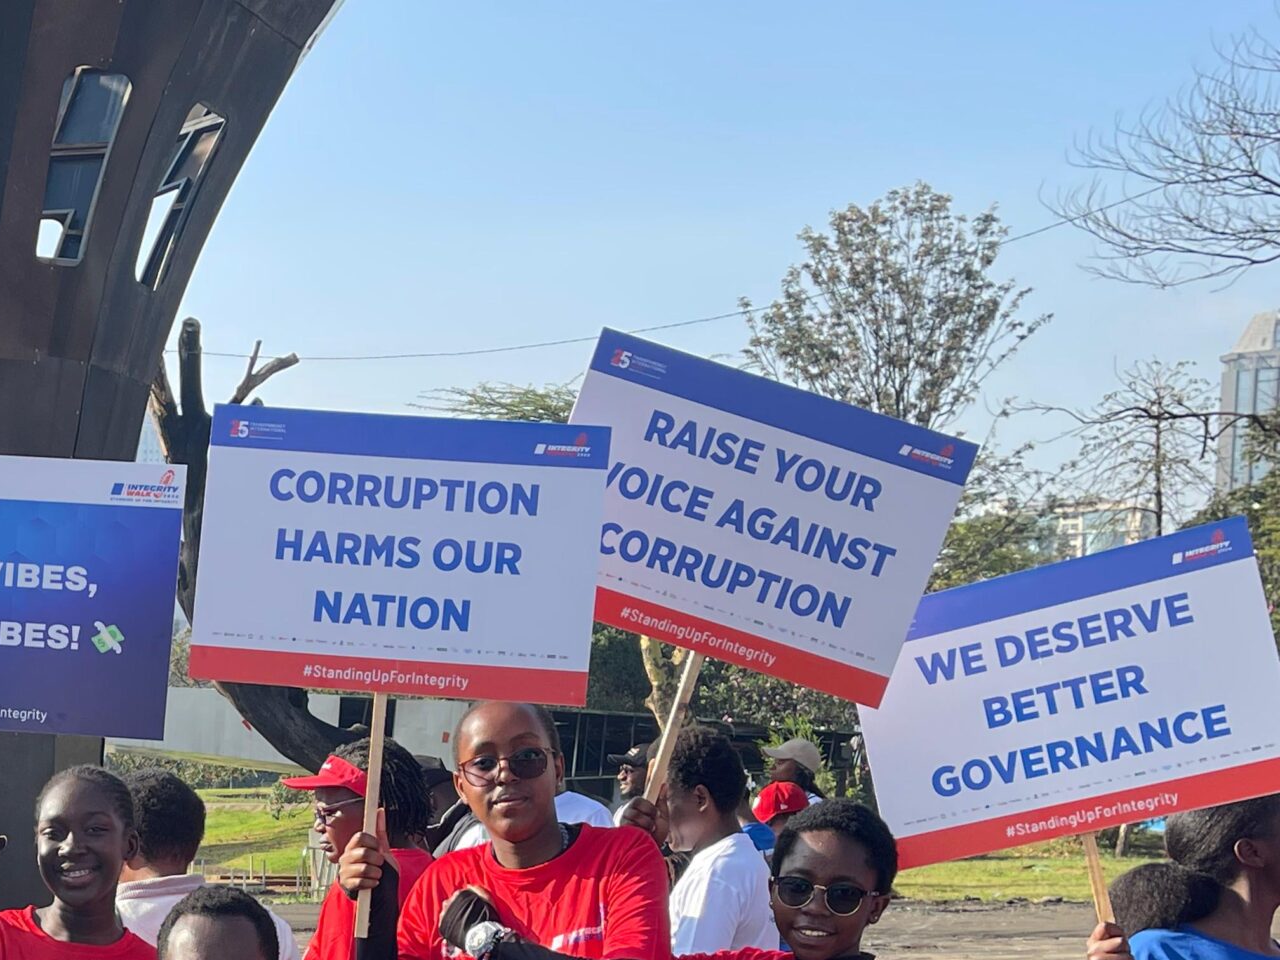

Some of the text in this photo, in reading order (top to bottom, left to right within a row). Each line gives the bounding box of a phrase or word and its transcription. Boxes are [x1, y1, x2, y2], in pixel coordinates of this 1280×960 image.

[127, 484, 179, 493] INTEGRITY
[644, 409, 882, 512] RAISE YOUR
[269, 469, 540, 516] CORRUPTION
[275, 528, 522, 575] HARMS OUR
[716, 499, 897, 577] AGAINST
[600, 522, 852, 628] CORRUPTION
[313, 590, 472, 632] NATION
[620, 606, 777, 667] #StandingUpForIntegrity
[914, 592, 1194, 686] WE DESERVE
[303, 665, 469, 690] #StandingUpForIntegrity
[982, 664, 1149, 729] BETTER
[931, 704, 1232, 797] GOVERNANCE
[1006, 791, 1179, 837] #StandingUpForIntegrity
